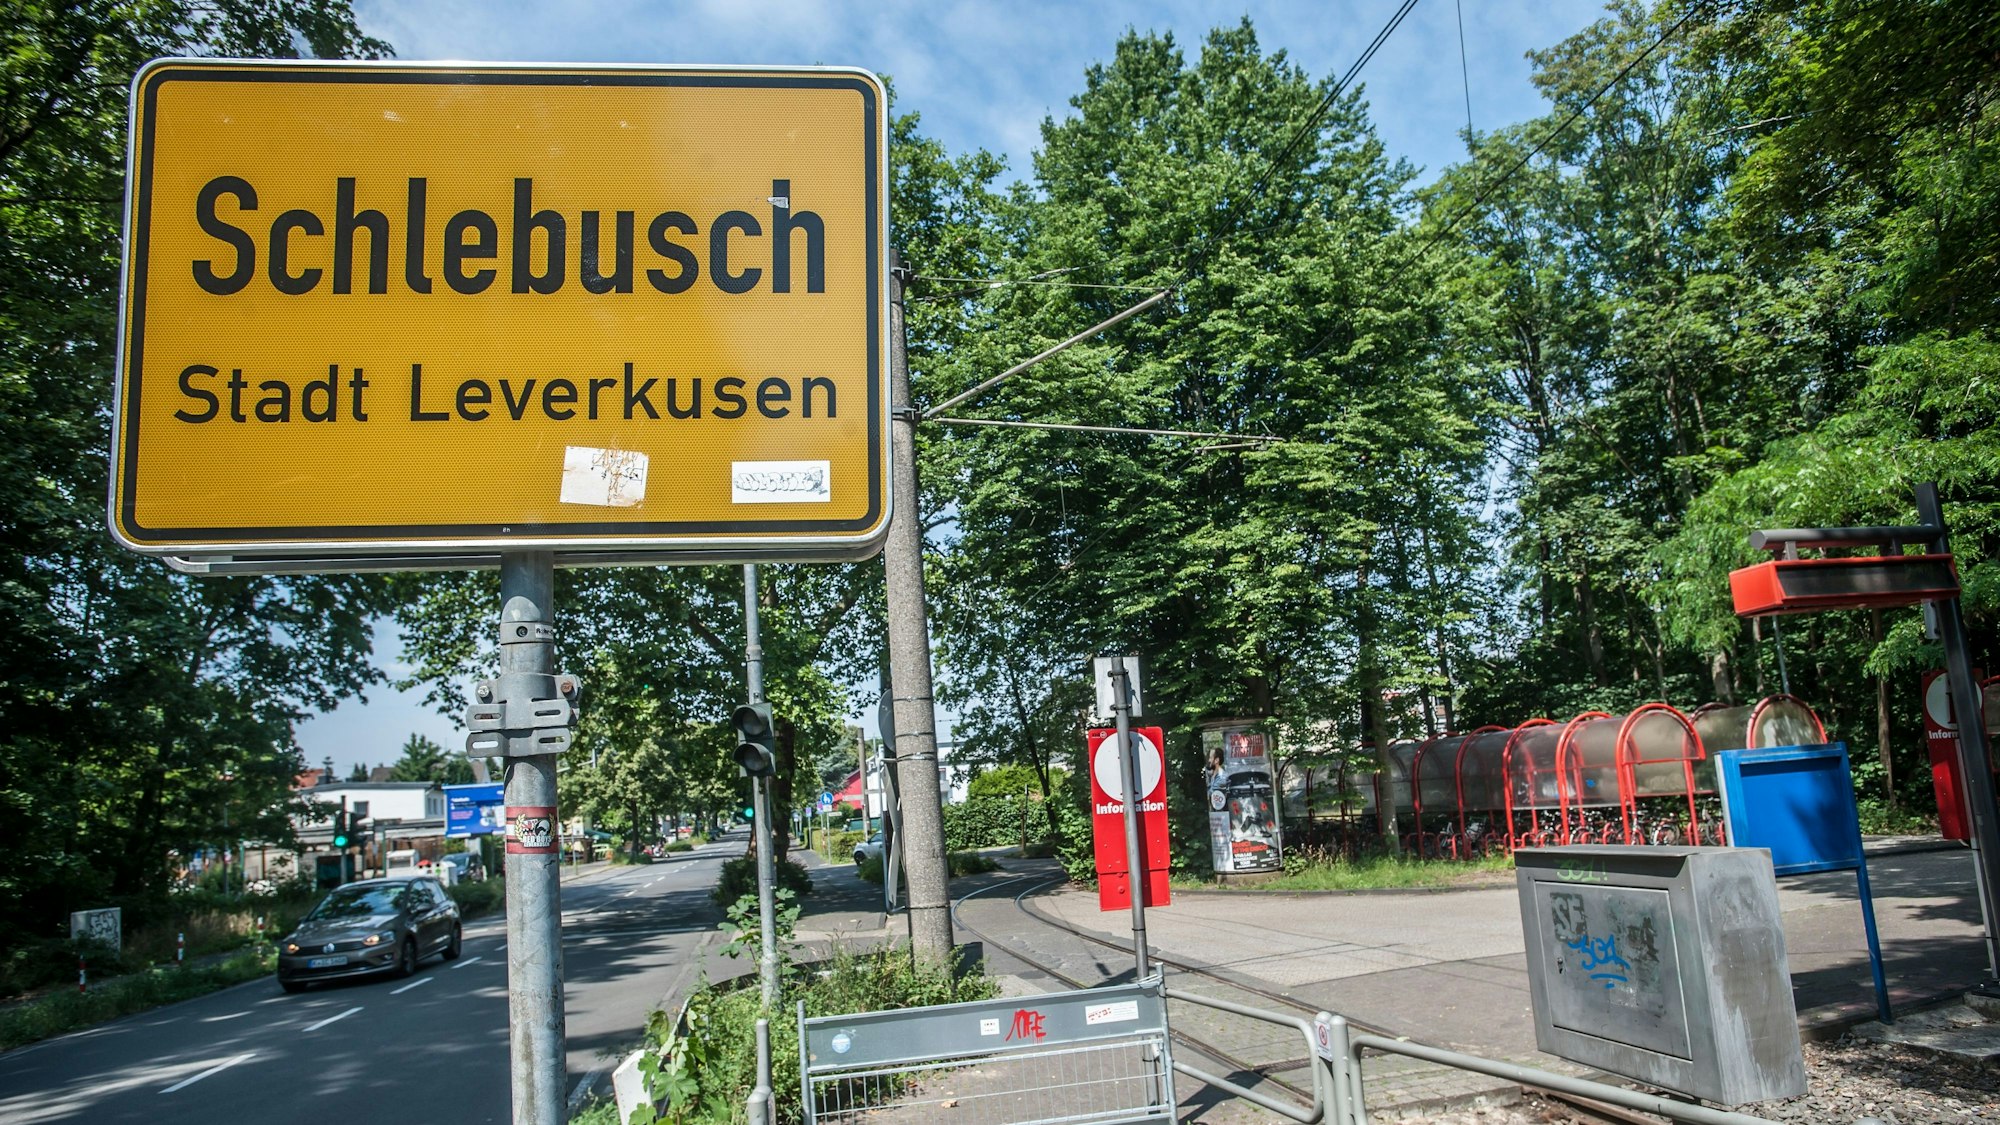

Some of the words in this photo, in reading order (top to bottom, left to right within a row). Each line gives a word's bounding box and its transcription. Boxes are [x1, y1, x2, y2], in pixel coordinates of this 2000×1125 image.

[192, 175, 825, 296] Schlebusch
[174, 363, 370, 423] Stadt
[411, 362, 837, 421] Leverkusen
[1096, 800, 1165, 814] Inforation
